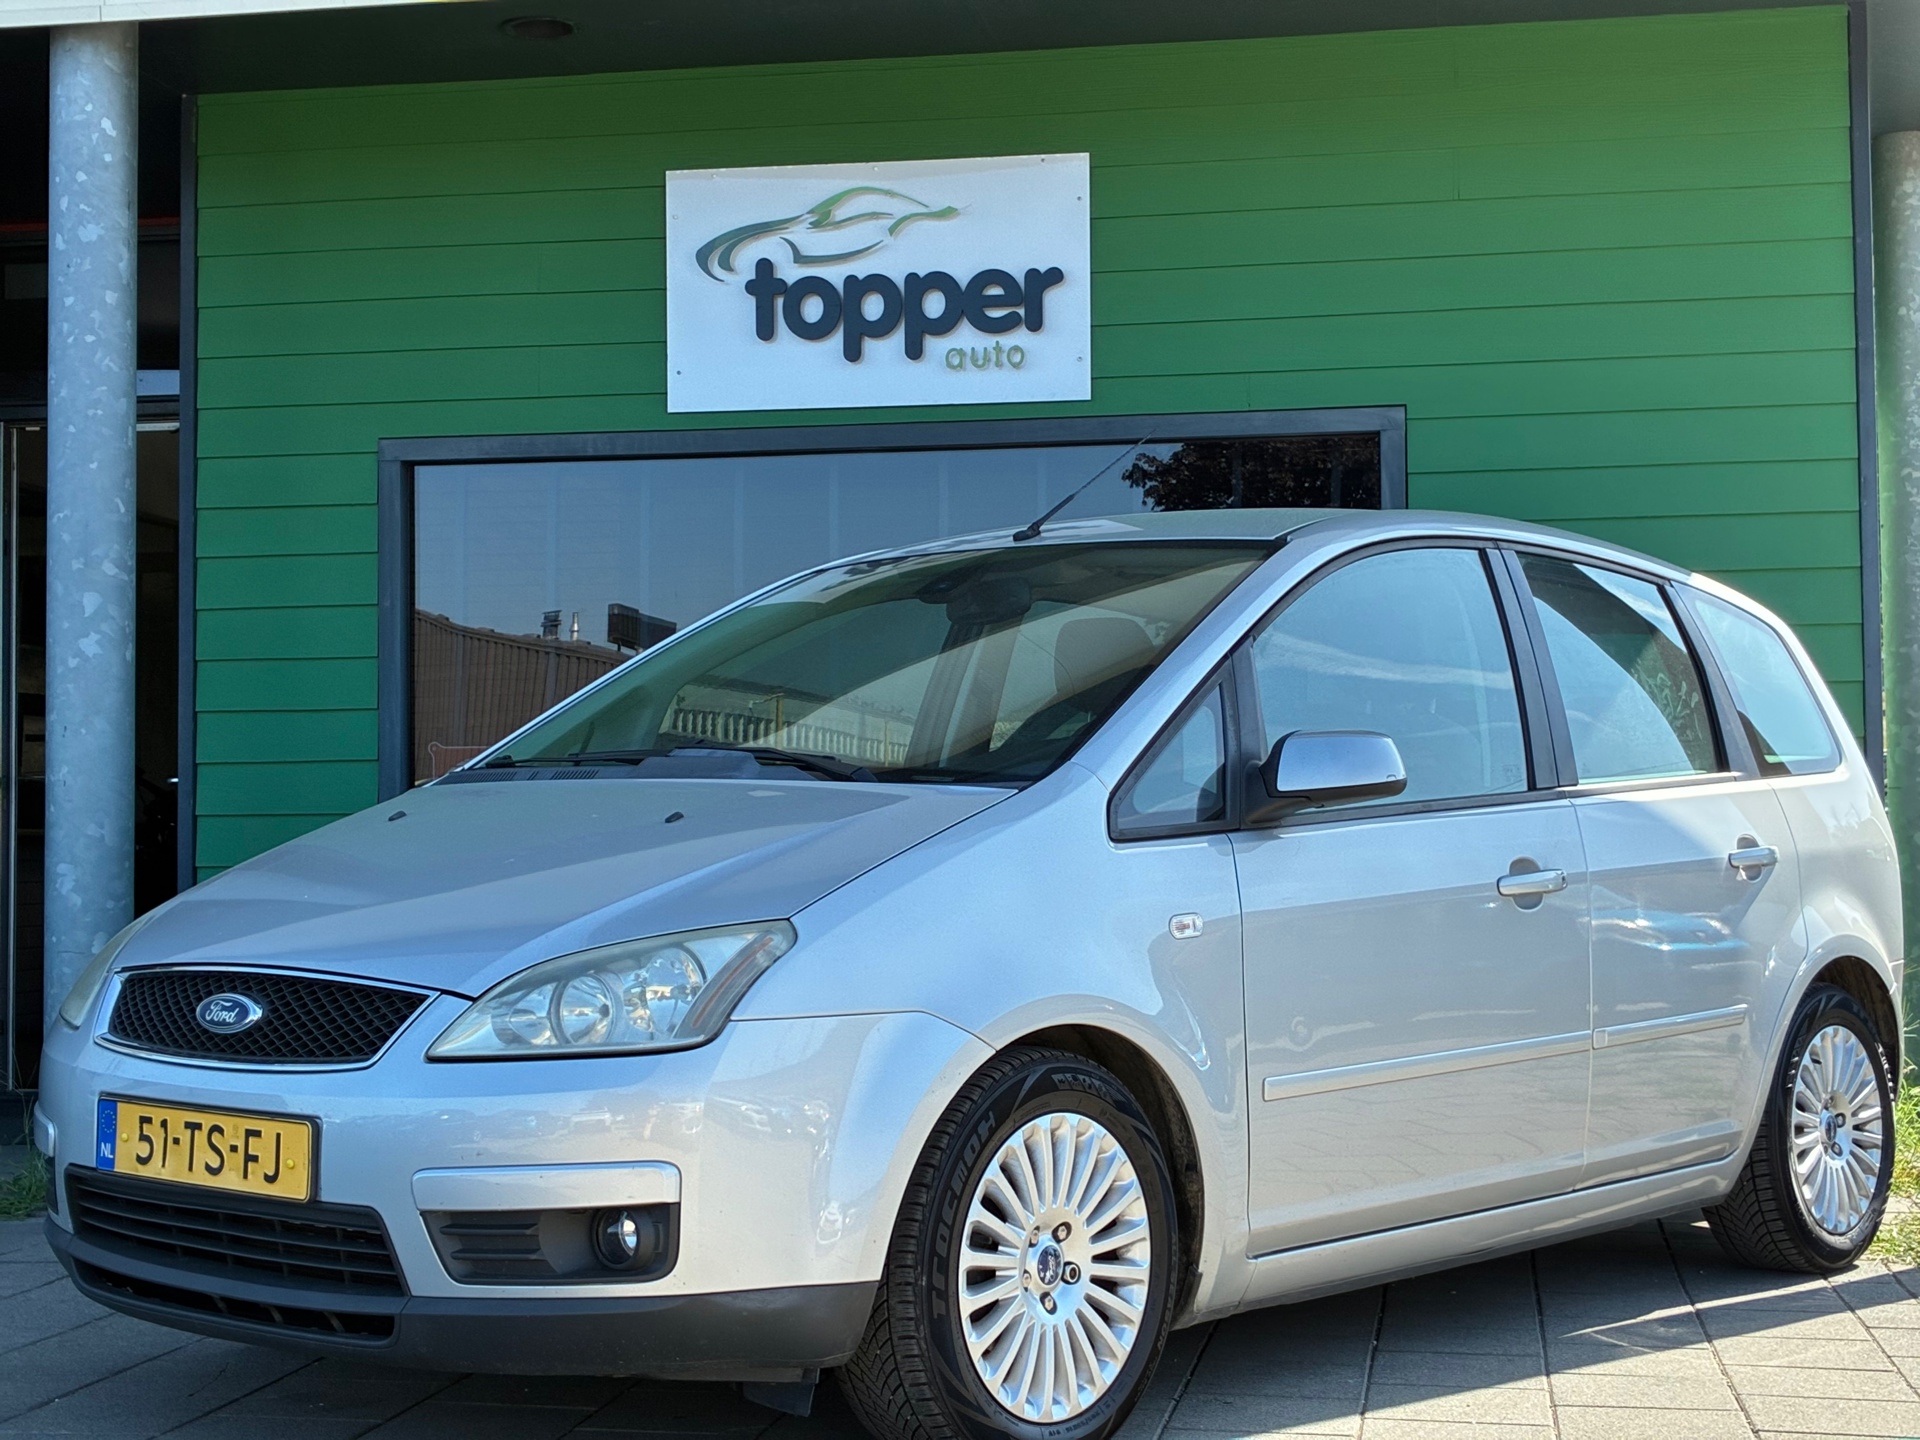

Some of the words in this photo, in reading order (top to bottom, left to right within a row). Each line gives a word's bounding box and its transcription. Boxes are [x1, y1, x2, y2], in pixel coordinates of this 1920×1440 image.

[744, 257, 1064, 362] topper
[944, 340, 1026, 370] auto
[205, 1000, 239, 1023] Ford
[100, 1142, 114, 1158] NL
[135, 1115, 282, 1184] 51-TS-FJ
